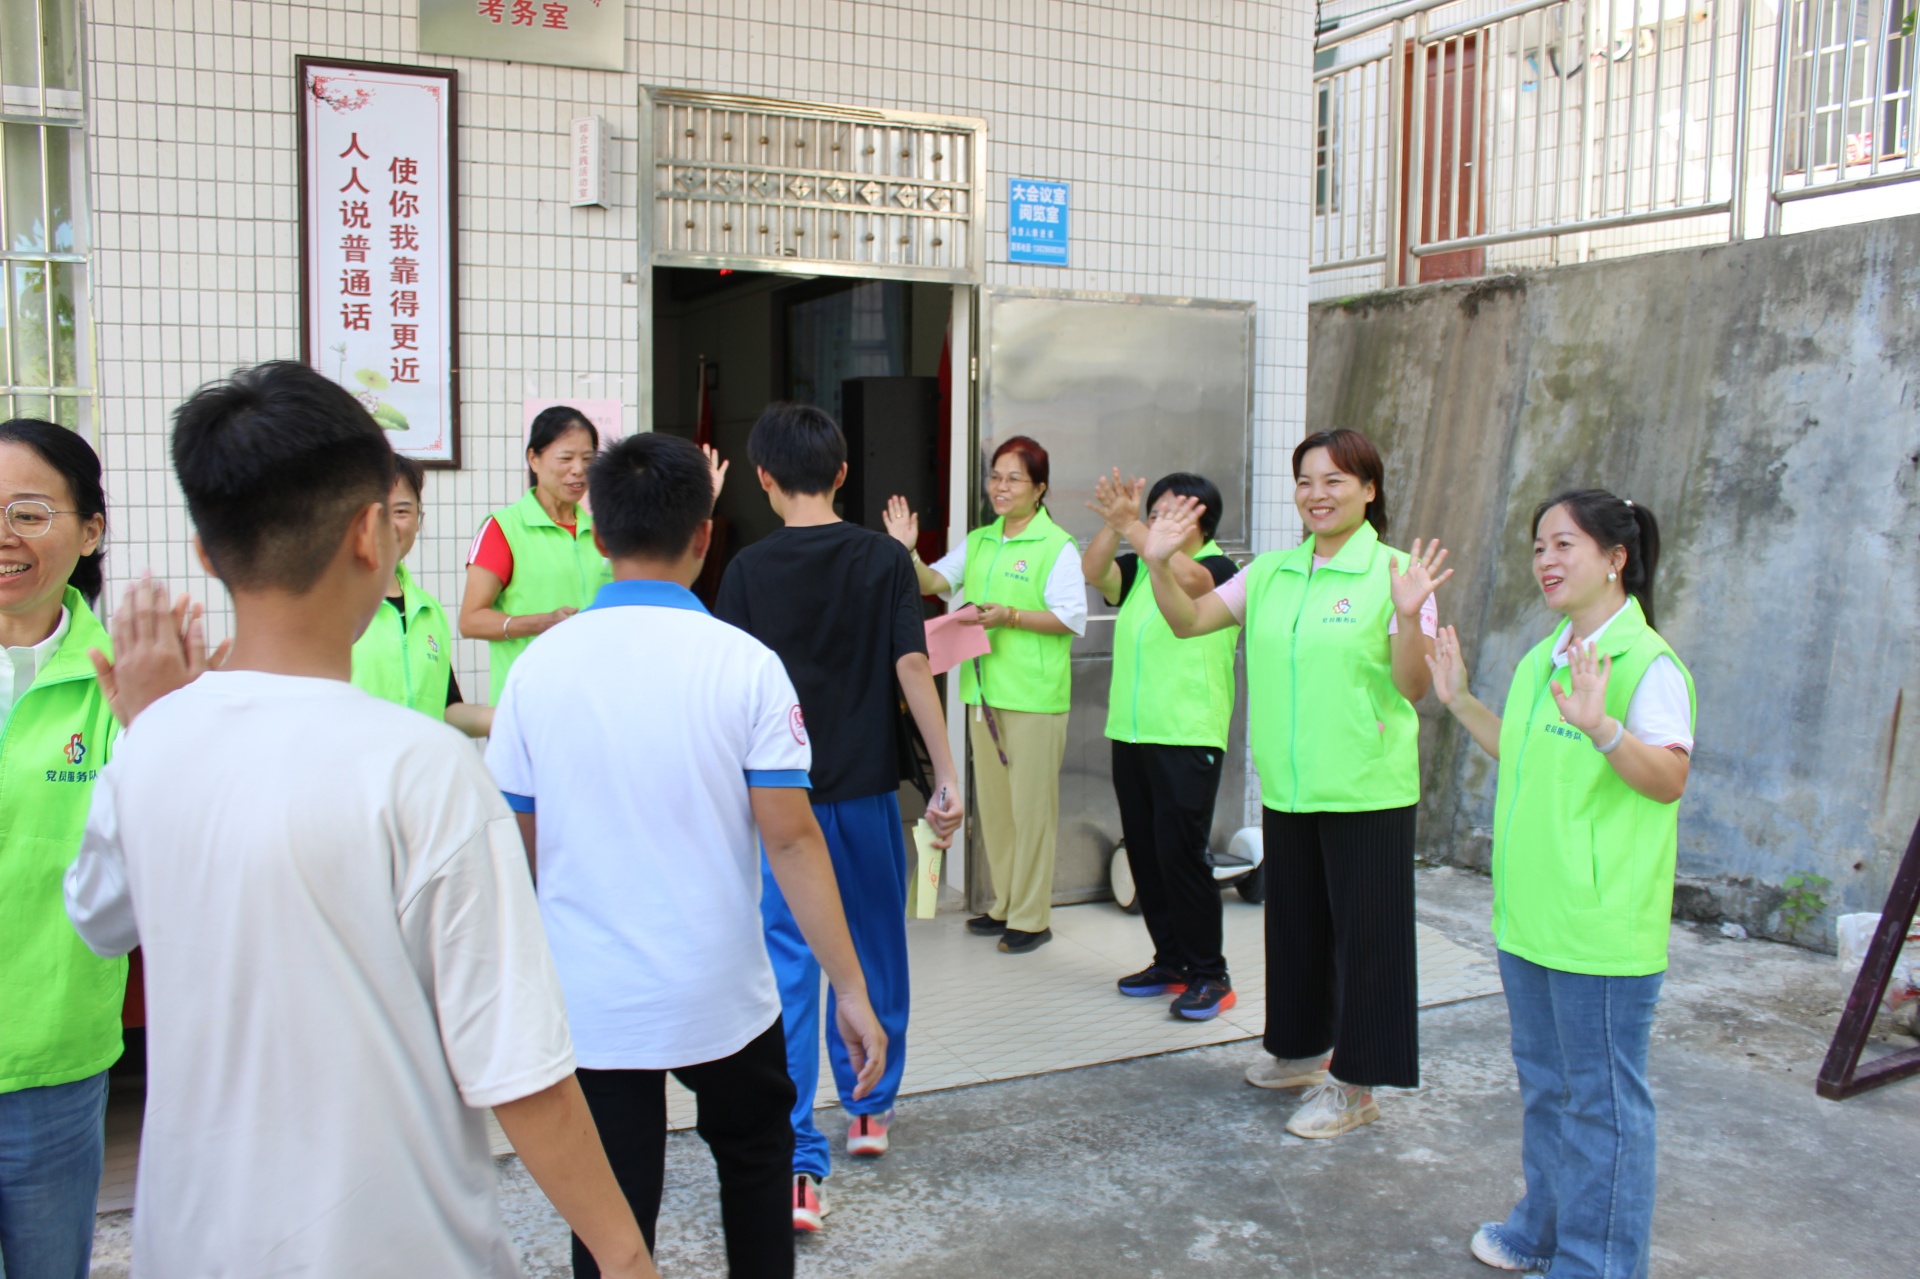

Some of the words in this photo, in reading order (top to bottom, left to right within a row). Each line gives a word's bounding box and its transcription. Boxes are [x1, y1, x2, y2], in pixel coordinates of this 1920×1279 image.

[478, 0, 568, 30] 考务室
[1012, 183, 1066, 205] 大会议室
[339, 132, 372, 332] 人人说普通话
[388, 156, 421, 384] 使你我靠得更近
[45, 769, 98, 782] 党员服务队
